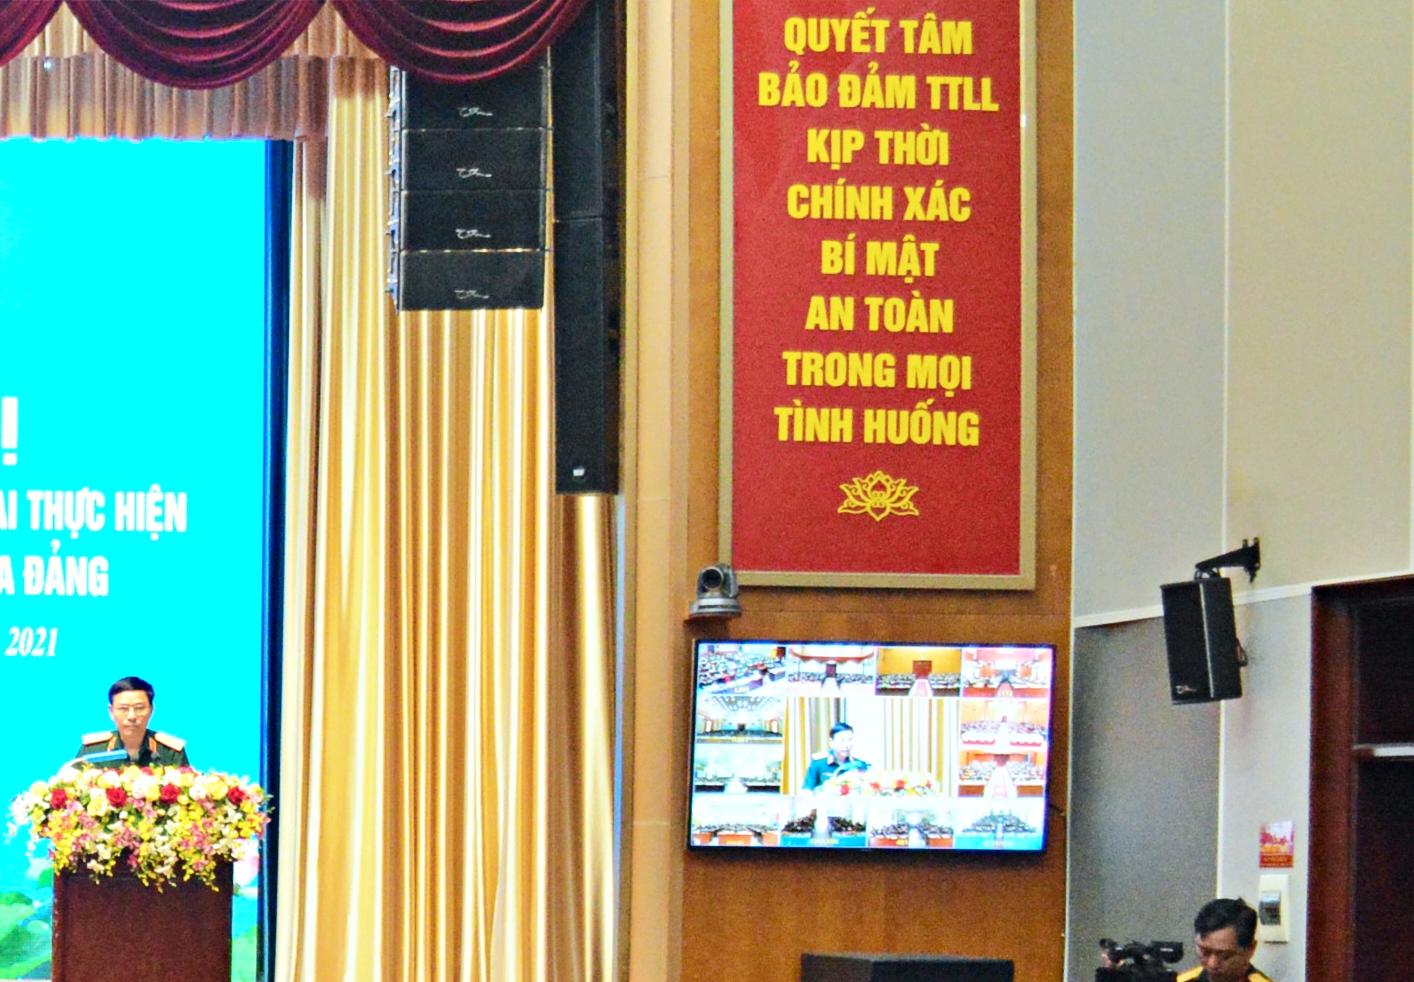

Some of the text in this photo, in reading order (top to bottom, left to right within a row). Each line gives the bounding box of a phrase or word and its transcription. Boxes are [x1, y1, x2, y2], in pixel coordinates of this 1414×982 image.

[784, 7, 972, 56] QUYẾT TÂM
[759, 60, 999, 111] BẢO ĐẢM TTLL
[808, 123, 948, 170] KỊP THỜI
[788, 178, 970, 221] CHÍNH XÁC
[822, 233, 939, 283] BÍ MẬT
[805, 291, 953, 332] AN TOÀN
[782, 351, 972, 398] TRONG MỌI
[774, 399, 979, 446] TÌNH HUỐNG
[27, 488, 105, 539] THỰC
[115, 484, 187, 540] HIỆN
[23, 538, 108, 596] ĐẢNG
[5, 627, 57, 656] 2021
